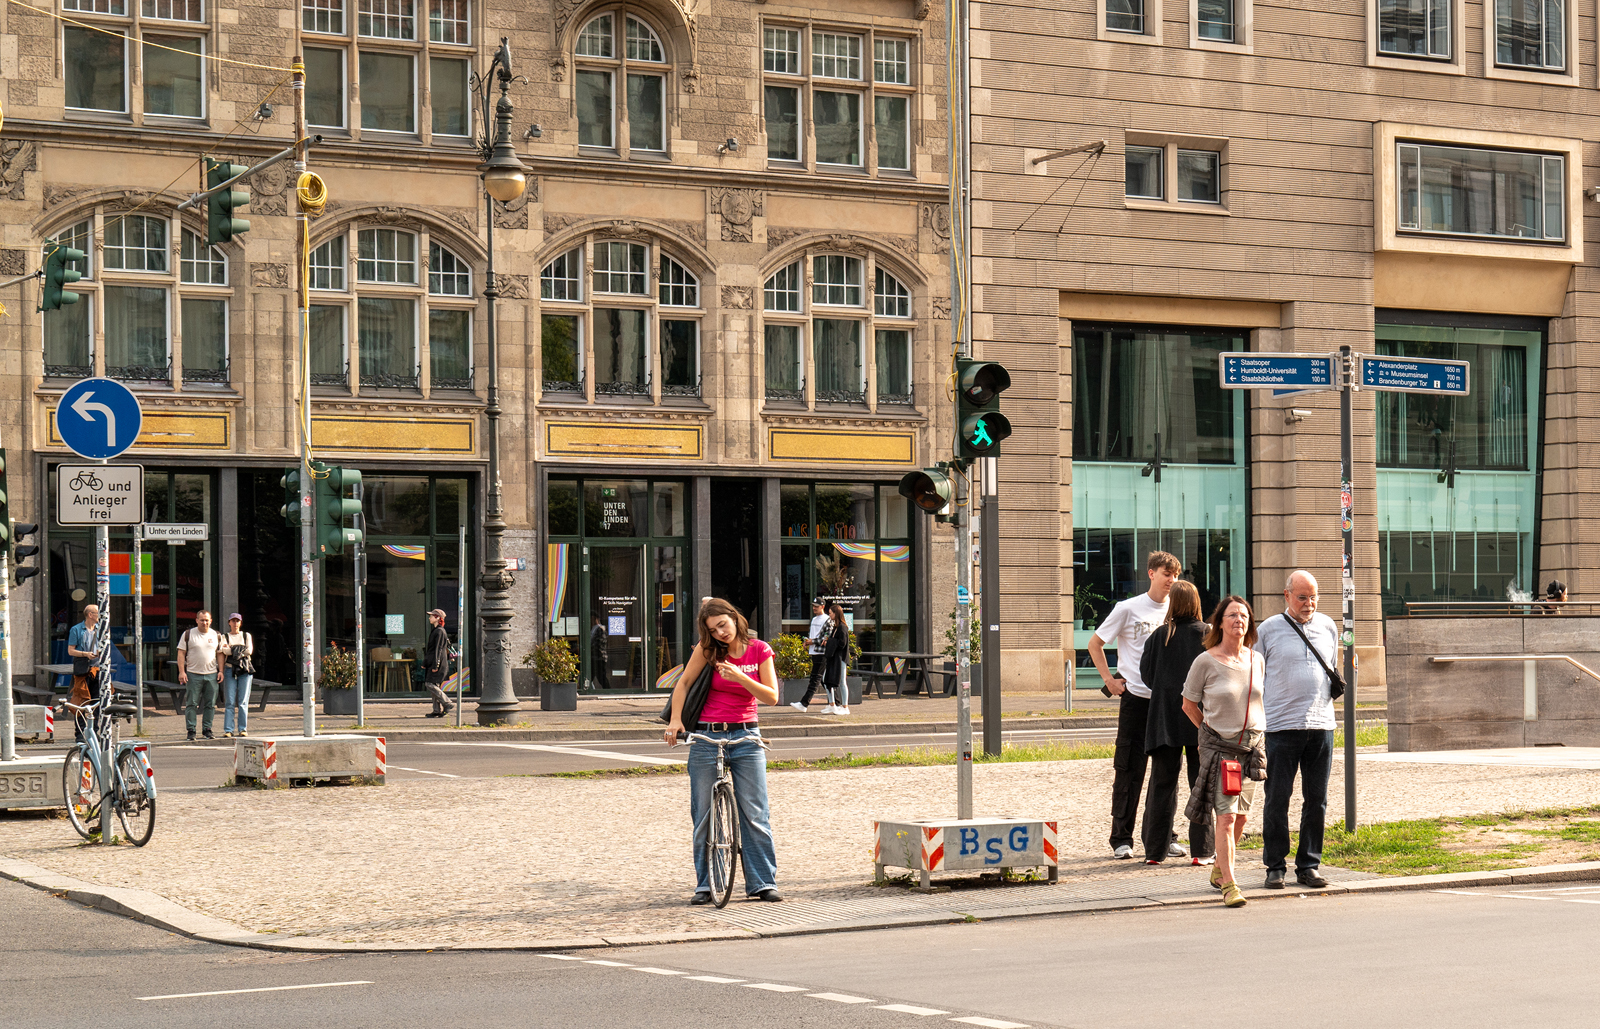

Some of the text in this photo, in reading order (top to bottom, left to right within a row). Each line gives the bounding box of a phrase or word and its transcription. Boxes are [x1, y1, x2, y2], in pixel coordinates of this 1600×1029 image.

[1379, 361, 1418, 371] Alexanderplatz
[1391, 370, 1428, 379] Museumsinsel
[1379, 378, 1418, 387] Brandenburger
[108, 481, 131, 491] und
[73, 494, 127, 507] Anlieger
[90, 508, 111, 519] frei
[149, 527, 203, 535] Unter den Linden
[604, 522, 611, 530] 17
[959, 826, 1029, 865] BSG
